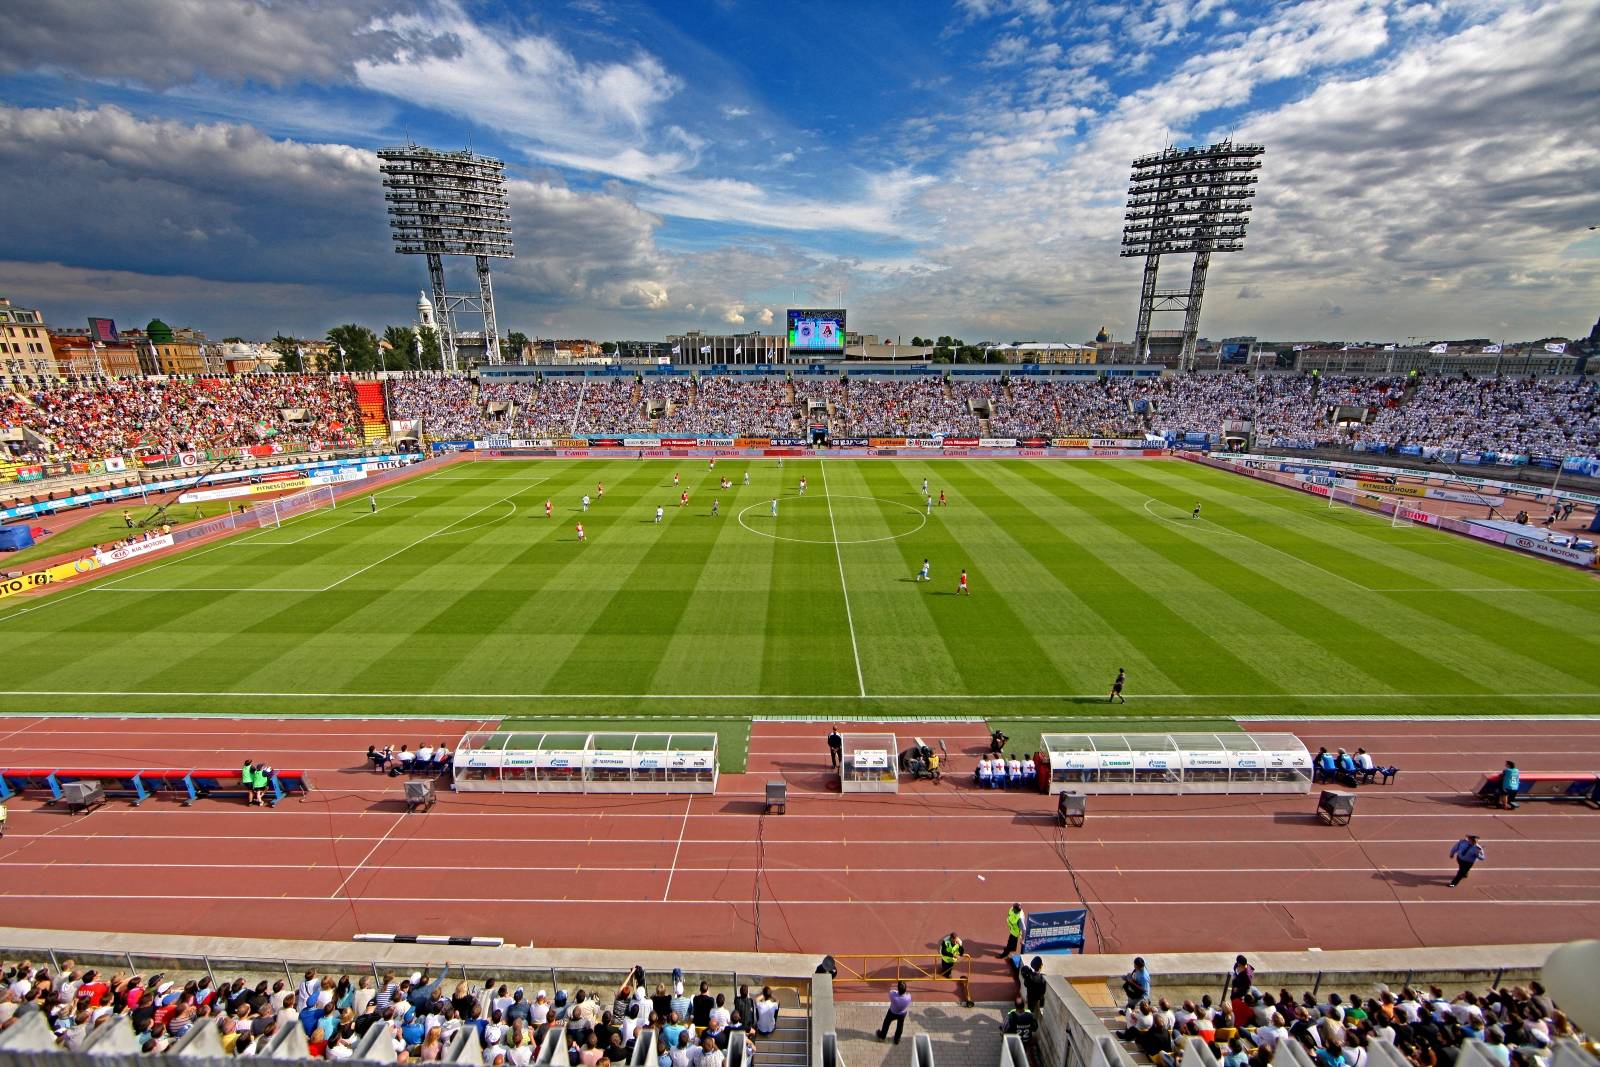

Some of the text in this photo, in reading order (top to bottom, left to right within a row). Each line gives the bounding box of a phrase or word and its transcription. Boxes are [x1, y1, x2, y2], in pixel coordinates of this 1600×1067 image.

[377, 461, 397, 469] ПТК
[256, 483, 281, 491] FITNESS
[286, 480, 305, 488] HOUSE
[1302, 483, 1329, 495] Canon
[1363, 483, 1388, 491] FITNESS
[187, 520, 225, 539] Canon
[143, 539, 167, 550] MOTORS
[114, 550, 127, 558] KIA
[1550, 547, 1579, 560] MOTORS
[0, 580, 23, 596] ТО
[1016, 1029, 1030, 1040] 22
